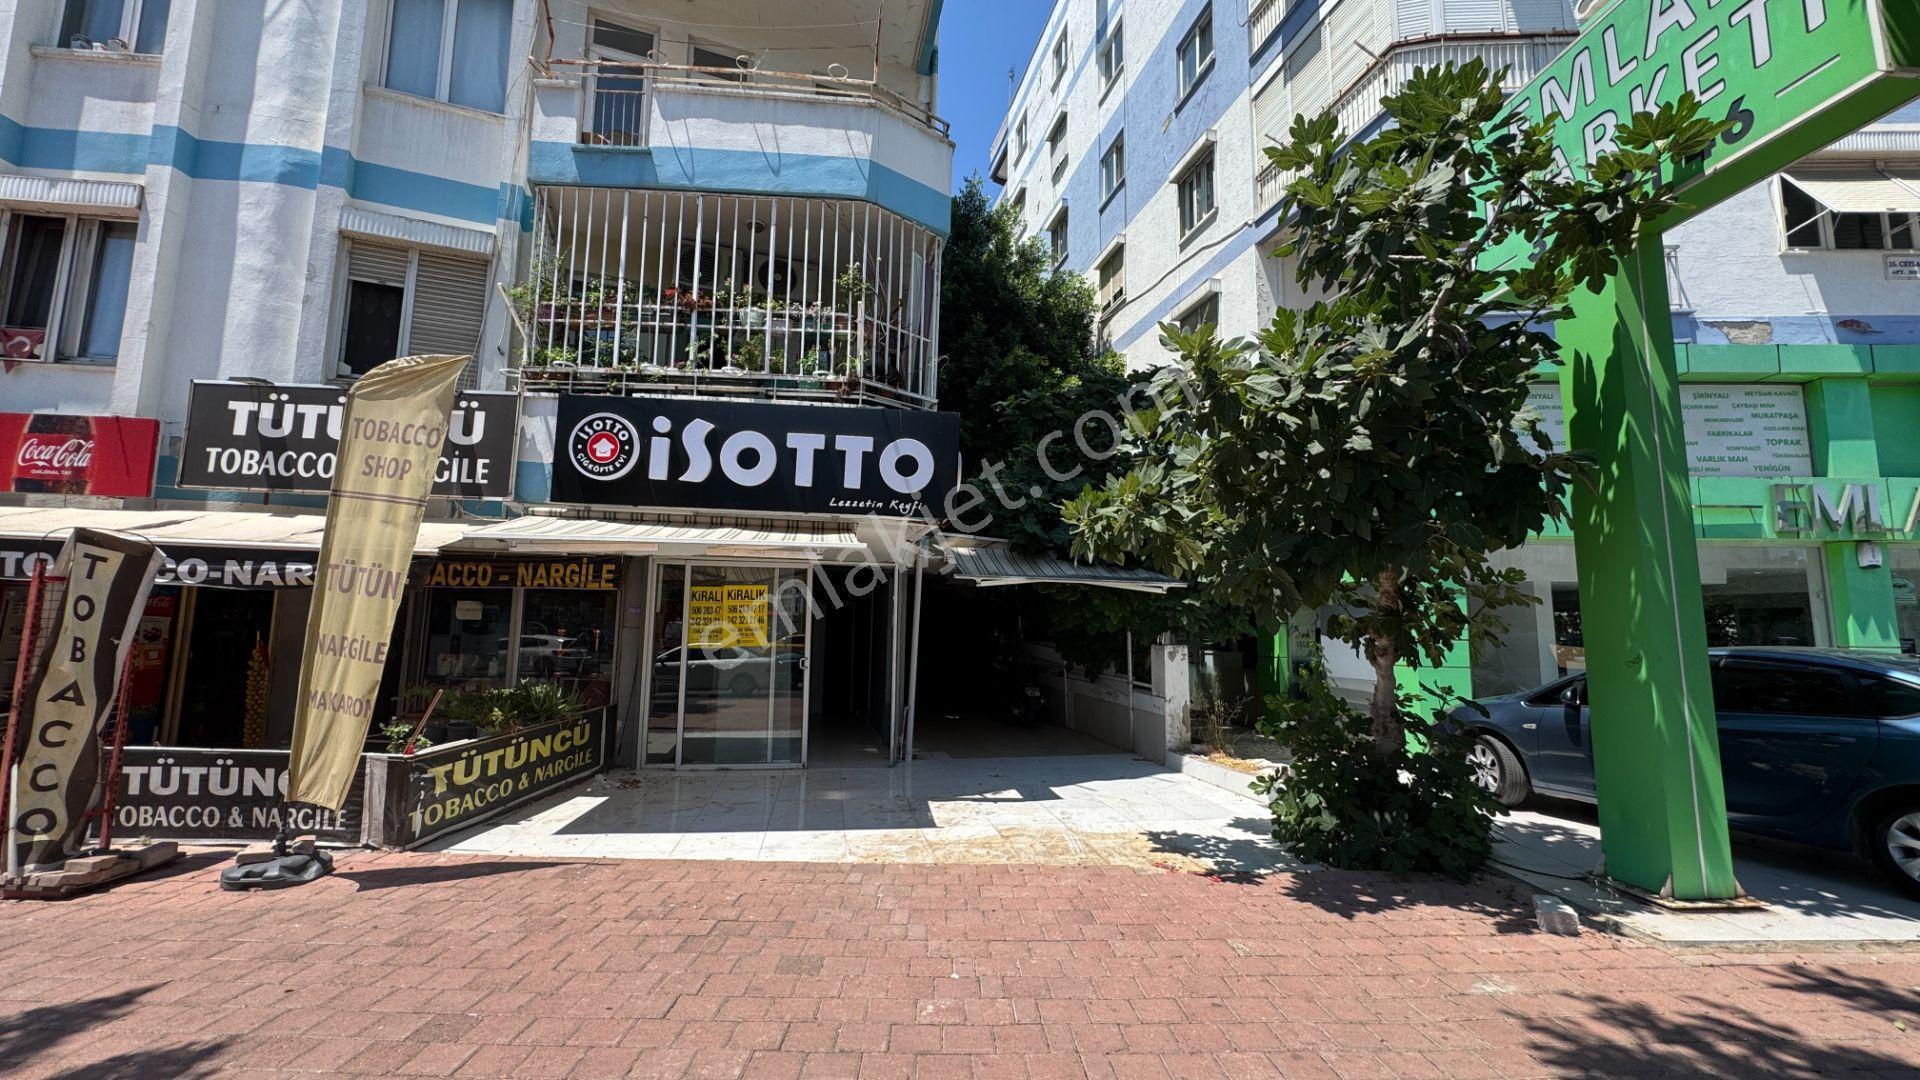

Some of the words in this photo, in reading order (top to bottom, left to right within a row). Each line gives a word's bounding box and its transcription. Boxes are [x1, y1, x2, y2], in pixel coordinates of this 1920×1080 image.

[1507, 0, 1721, 152] EMLA
[353, 417, 442, 450] TOBACCO
[1765, 438, 1802, 446] TOPRAK
[18, 438, 95, 468] Coca-Cola
[206, 447, 337, 479] TOBACCO
[362, 455, 412, 481] SHOP
[1696, 455, 1726, 463] VARLIK
[1728, 455, 1749, 463] MAH
[327, 559, 401, 600] TÜTÜN
[517, 557, 616, 588] NARGİLE
[318, 634, 388, 664] NARGİLE
[427, 719, 591, 794] TÜTÜNCÜ
[408, 778, 513, 834] TOBACCO
[518, 772, 529, 790] &
[533, 748, 593, 785] NARGİLE
[228, 806, 244, 829] &
